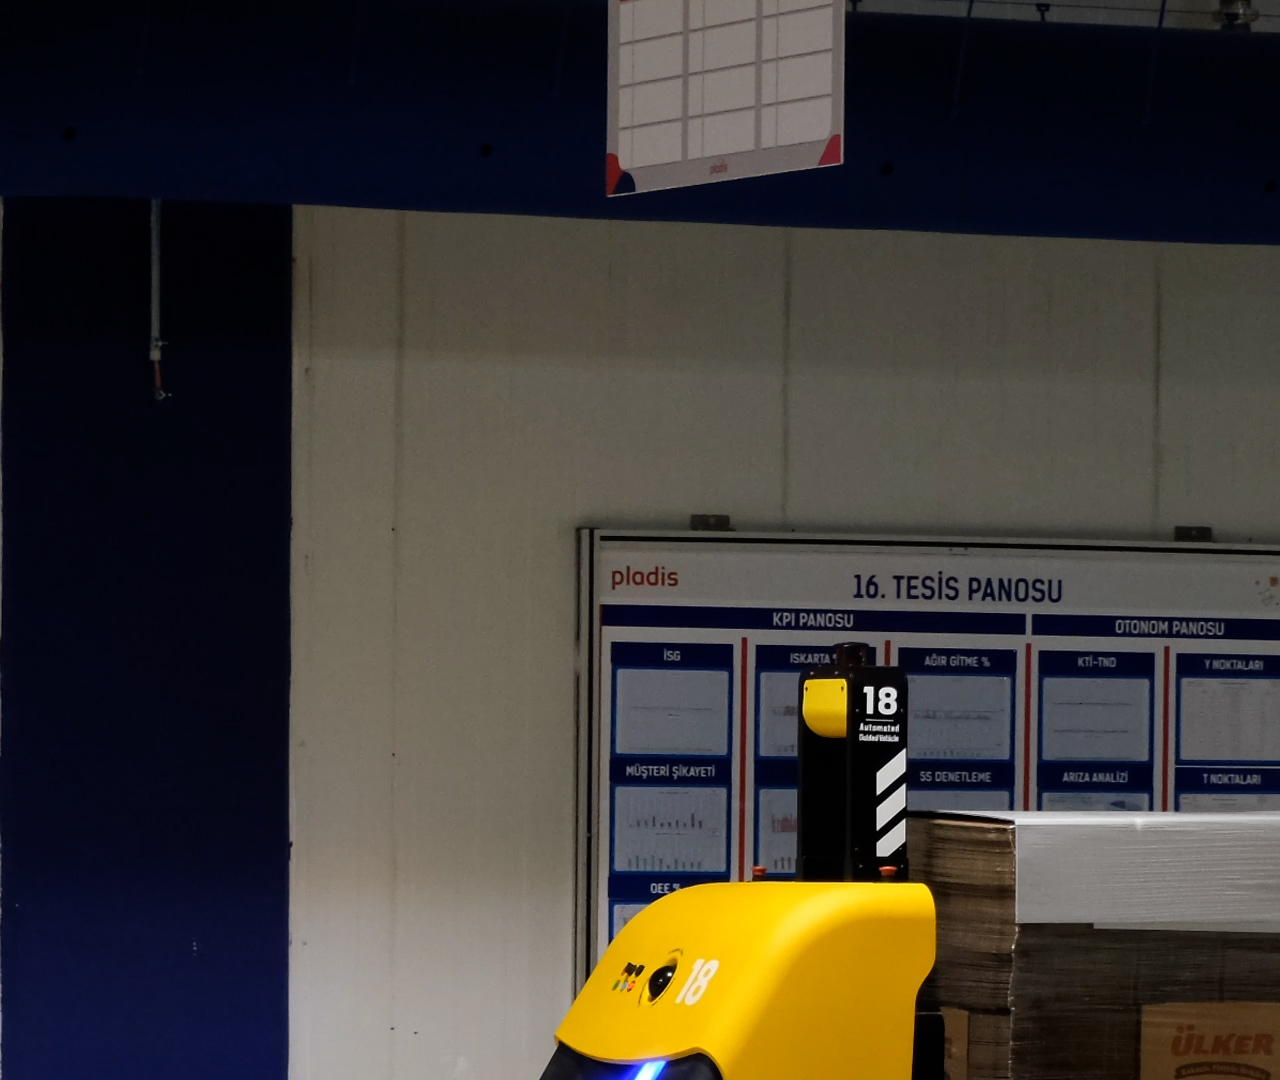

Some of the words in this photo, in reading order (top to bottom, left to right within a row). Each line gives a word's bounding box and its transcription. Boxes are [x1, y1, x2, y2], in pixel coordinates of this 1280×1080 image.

[612, 566, 679, 590] pladis
[853, 574, 885, 600] 16.
[892, 570, 960, 602] TESİS
[968, 577, 1063, 603] PANOSU
[772, 612, 795, 627] KPI
[799, 613, 854, 628] PANOSU
[1115, 619, 1168, 634] OTONOM
[1172, 621, 1225, 636] PANOSU
[663, 649, 681, 661] İSG
[790, 652, 830, 664] ISKARTA
[924, 653, 947, 666] AĞIR
[950, 654, 979, 667] GİTME
[981, 656, 991, 667] %
[1204, 659, 1210, 669] Y
[1212, 659, 1264, 670] NOKTALARI
[863, 686, 898, 715] 18
[626, 764, 670, 779] MÜŞTERİ
[672, 764, 716, 780] ŞİKAYETİ
[935, 771, 992, 782] DENETLEME
[1062, 772, 1090, 783] ARIZA
[1091, 770, 1129, 783] ANALİZİ
[1209, 774, 1262, 785] NOKTALARI
[650, 883, 670, 893] OEE
[674, 958, 719, 1007] 18
[1171, 1024, 1274, 1057] ÜLKER
